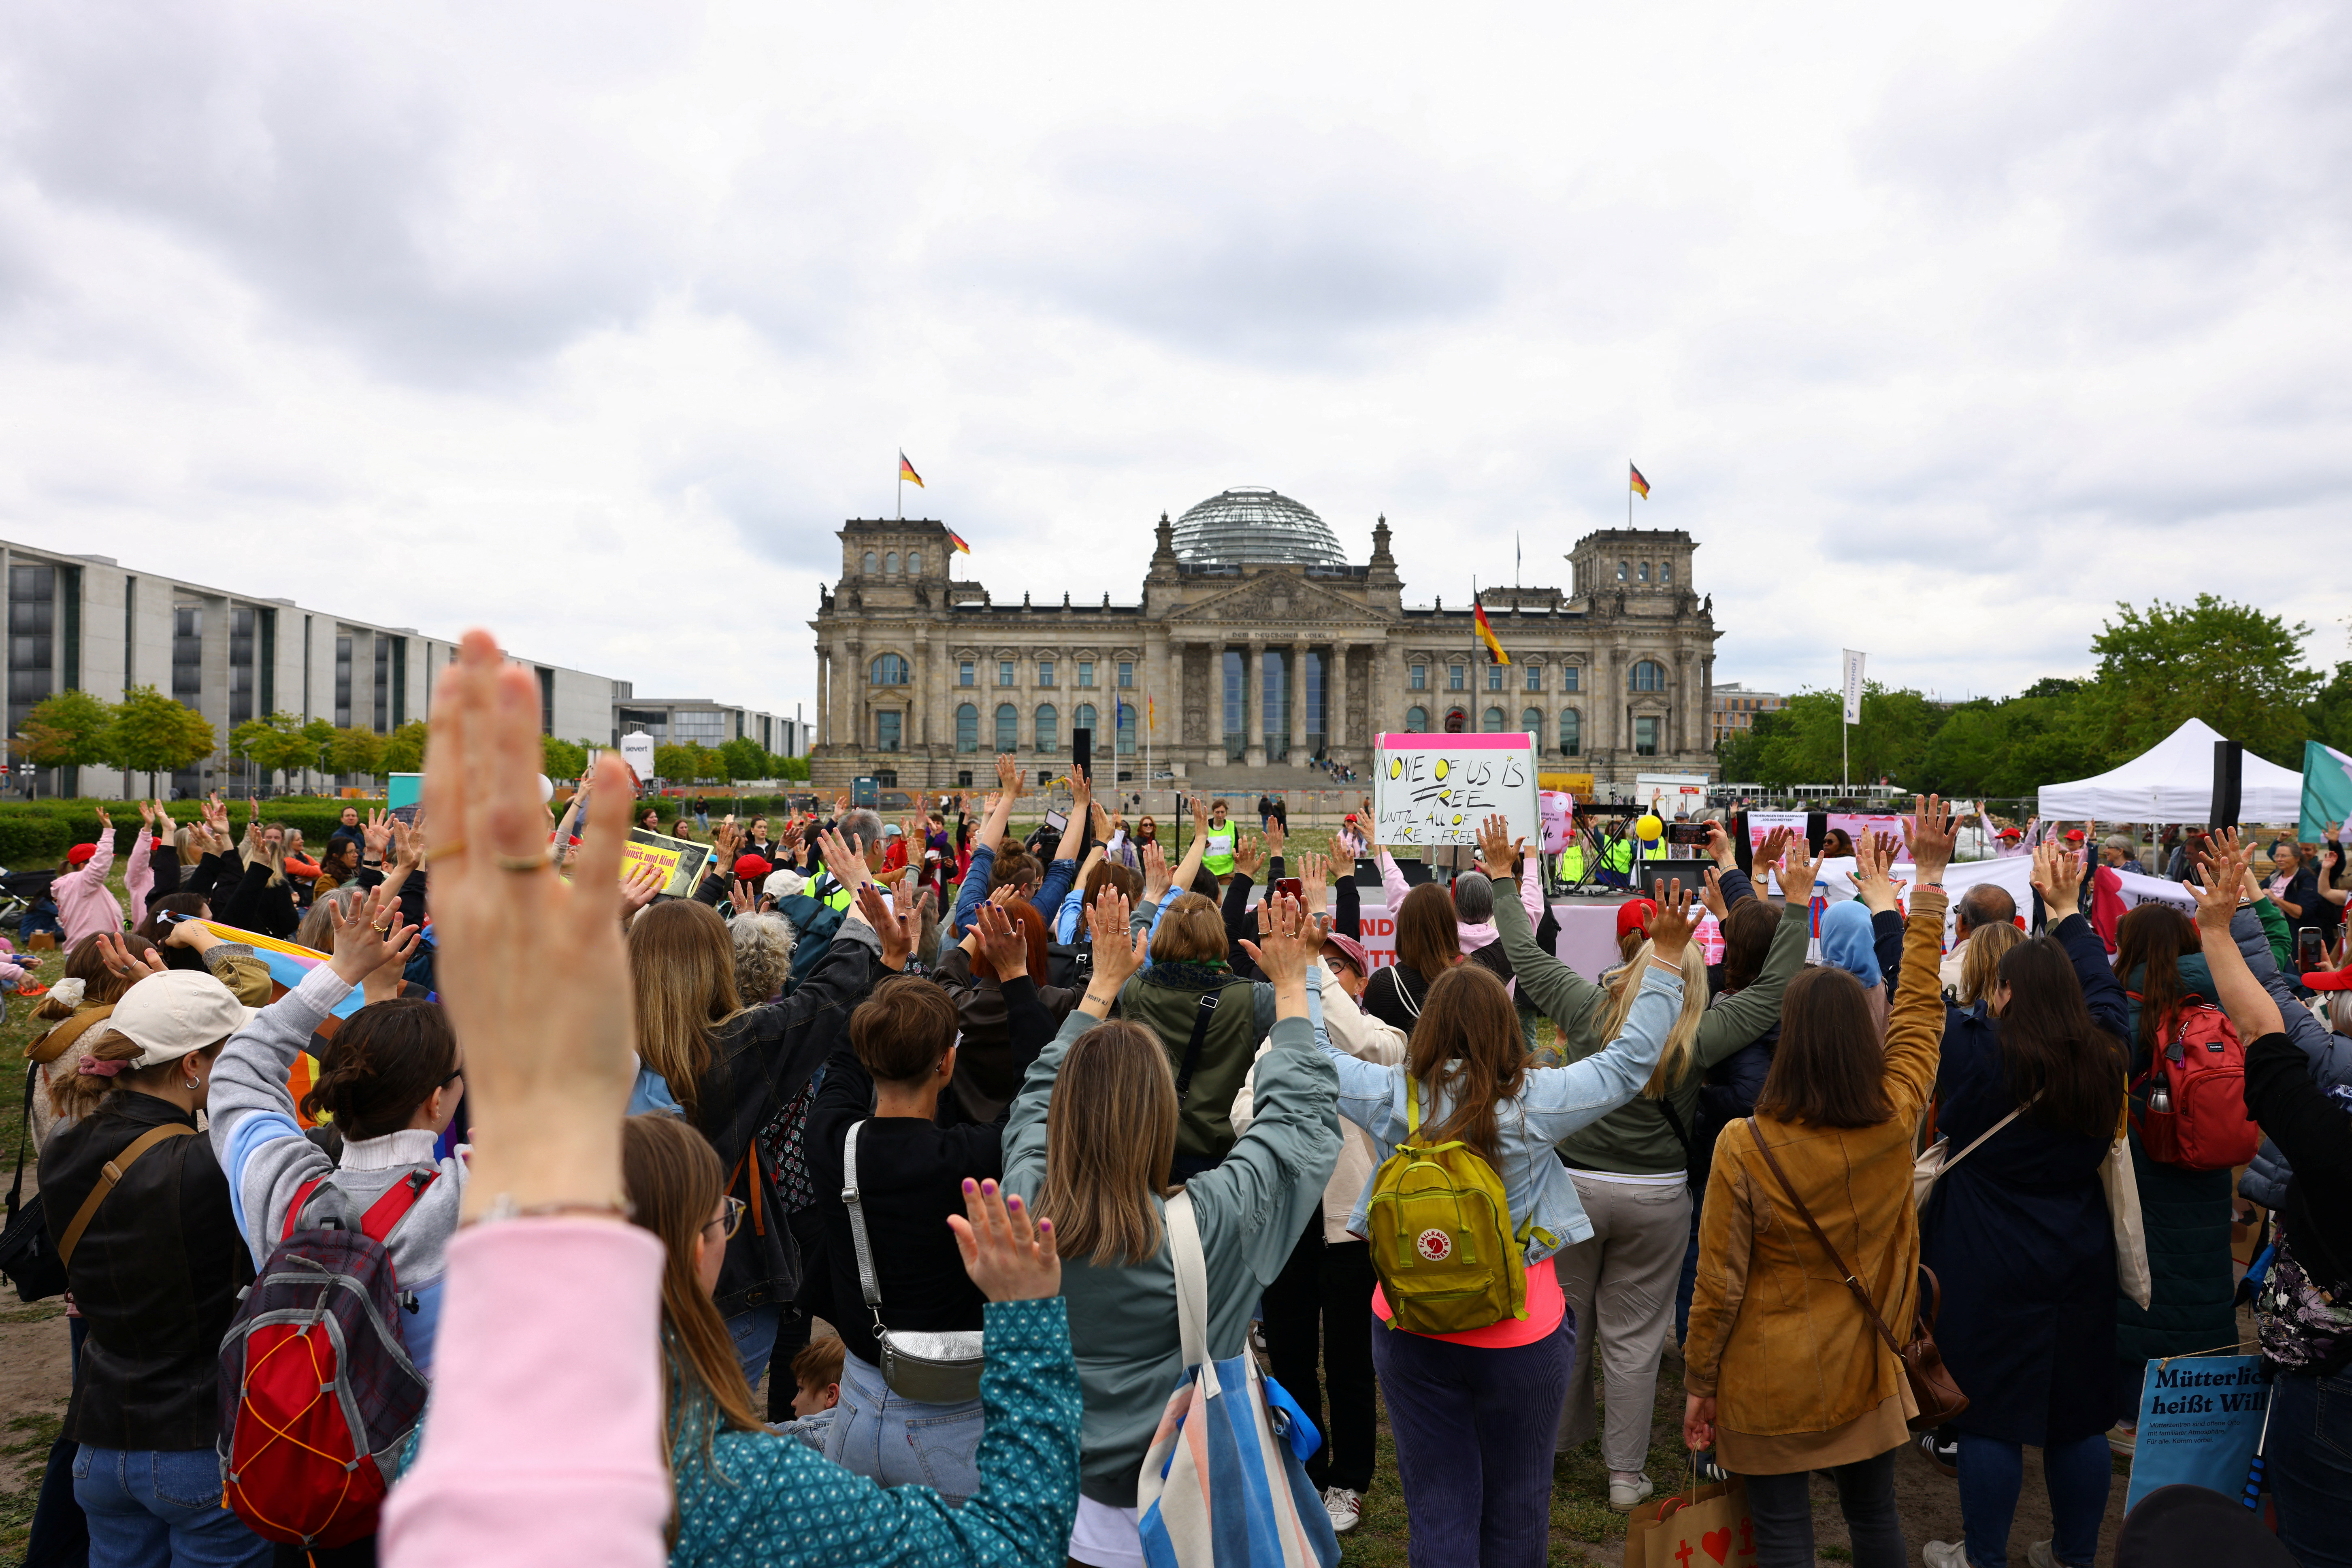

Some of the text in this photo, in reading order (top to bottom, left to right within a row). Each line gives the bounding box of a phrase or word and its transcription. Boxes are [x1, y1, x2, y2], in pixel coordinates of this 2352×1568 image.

[1378, 752, 1425, 782] NONE
[1435, 758, 1460, 783] OF
[1467, 760, 1491, 786] US
[1410, 784, 1496, 808] FREE
[1452, 814, 1472, 826] OF
[1391, 825, 1475, 844] ARE FREE
[644, 853, 659, 863] und
[659, 855, 676, 867] Kind
[1086, 993, 1101, 1002] ALRIGHT
[1419, 1231, 1449, 1248] FJALLRAVEN
[1423, 1249, 1448, 1259] KANKEN
[2155, 1366, 2267, 1388] Mütterlic
[2151, 1394, 2213, 1414] heißt
